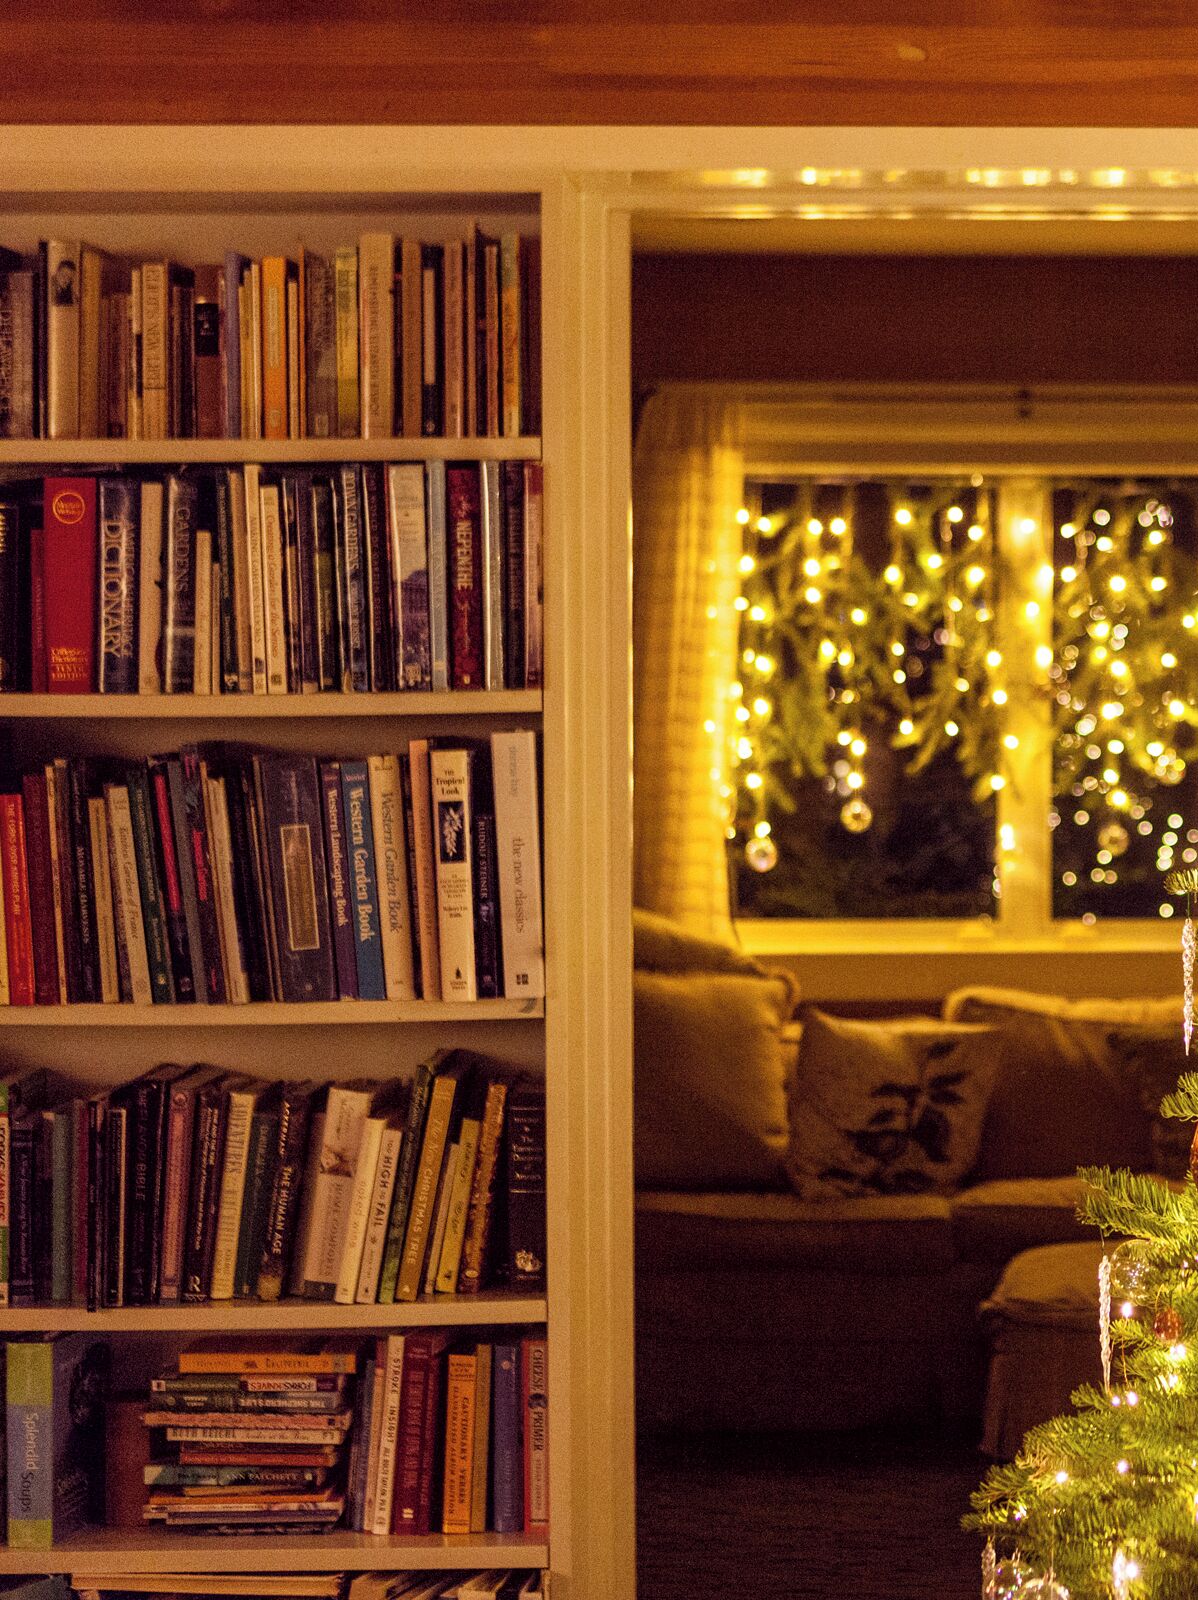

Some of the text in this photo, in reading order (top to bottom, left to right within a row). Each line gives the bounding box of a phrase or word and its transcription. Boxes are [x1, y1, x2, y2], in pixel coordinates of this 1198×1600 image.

[174, 507, 192, 593] GARDENS
[346, 513, 360, 570] GARDENS
[457, 520, 473, 591] NEPENTHE
[104, 521, 122, 658] DICTIONARY
[121, 522, 135, 657] AMERICAN HERITAGE
[251, 560, 261, 603] GARDEN
[268, 562, 278, 593] Garden
[270, 612, 280, 625] the
[374, 598, 382, 634] DESIGN
[271, 628, 280, 658] Senses
[436, 777, 465, 787] Tropical
[441, 787, 460, 795] Look
[328, 789, 341, 831] Western
[119, 827, 130, 860] Kitchen
[380, 791, 402, 934] Western Garden Book
[477, 821, 489, 899] RUDOLF STEINER
[123, 861, 135, 896] Gardens
[330, 833, 345, 898] Landscaping
[350, 787, 376, 942] Western Garden Book
[77, 846, 90, 944] MOVABLE HARVESTS
[512, 837, 528, 934] the new classics
[129, 910, 139, 940] France
[336, 899, 349, 927] Book
[225, 1102, 248, 1175] ADVENTURES
[279, 1101, 291, 1156] ACKERMAN
[135, 1163, 146, 1201] BIBLE
[281, 1166, 292, 1187] THE
[379, 1155, 394, 1188] HIGH
[276, 1189, 290, 1230] HUMAN
[355, 1181, 368, 1215] naked
[373, 1202, 388, 1228] FAIL
[413, 1168, 433, 1233] CHRISTMAS
[272, 1232, 283, 1255] AGE
[323, 1219, 341, 1279] COMFORTS
[407, 1236, 421, 1265] TREE
[250, 1380, 282, 1391] KNIVES
[390, 1358, 401, 1395] STROKE
[532, 1349, 544, 1391] CHEESE
[387, 1405, 398, 1444] INSIGHT
[532, 1411, 544, 1451] PRIMER
[18, 1412, 40, 1512] Splendid Soups
[448, 1385, 459, 1515] ILLUSTRATED ALBUM EDITION
[459, 1396, 470, 1504] CAUTIONARY VERSES
[248, 1472, 298, 1481] PATCHETT
